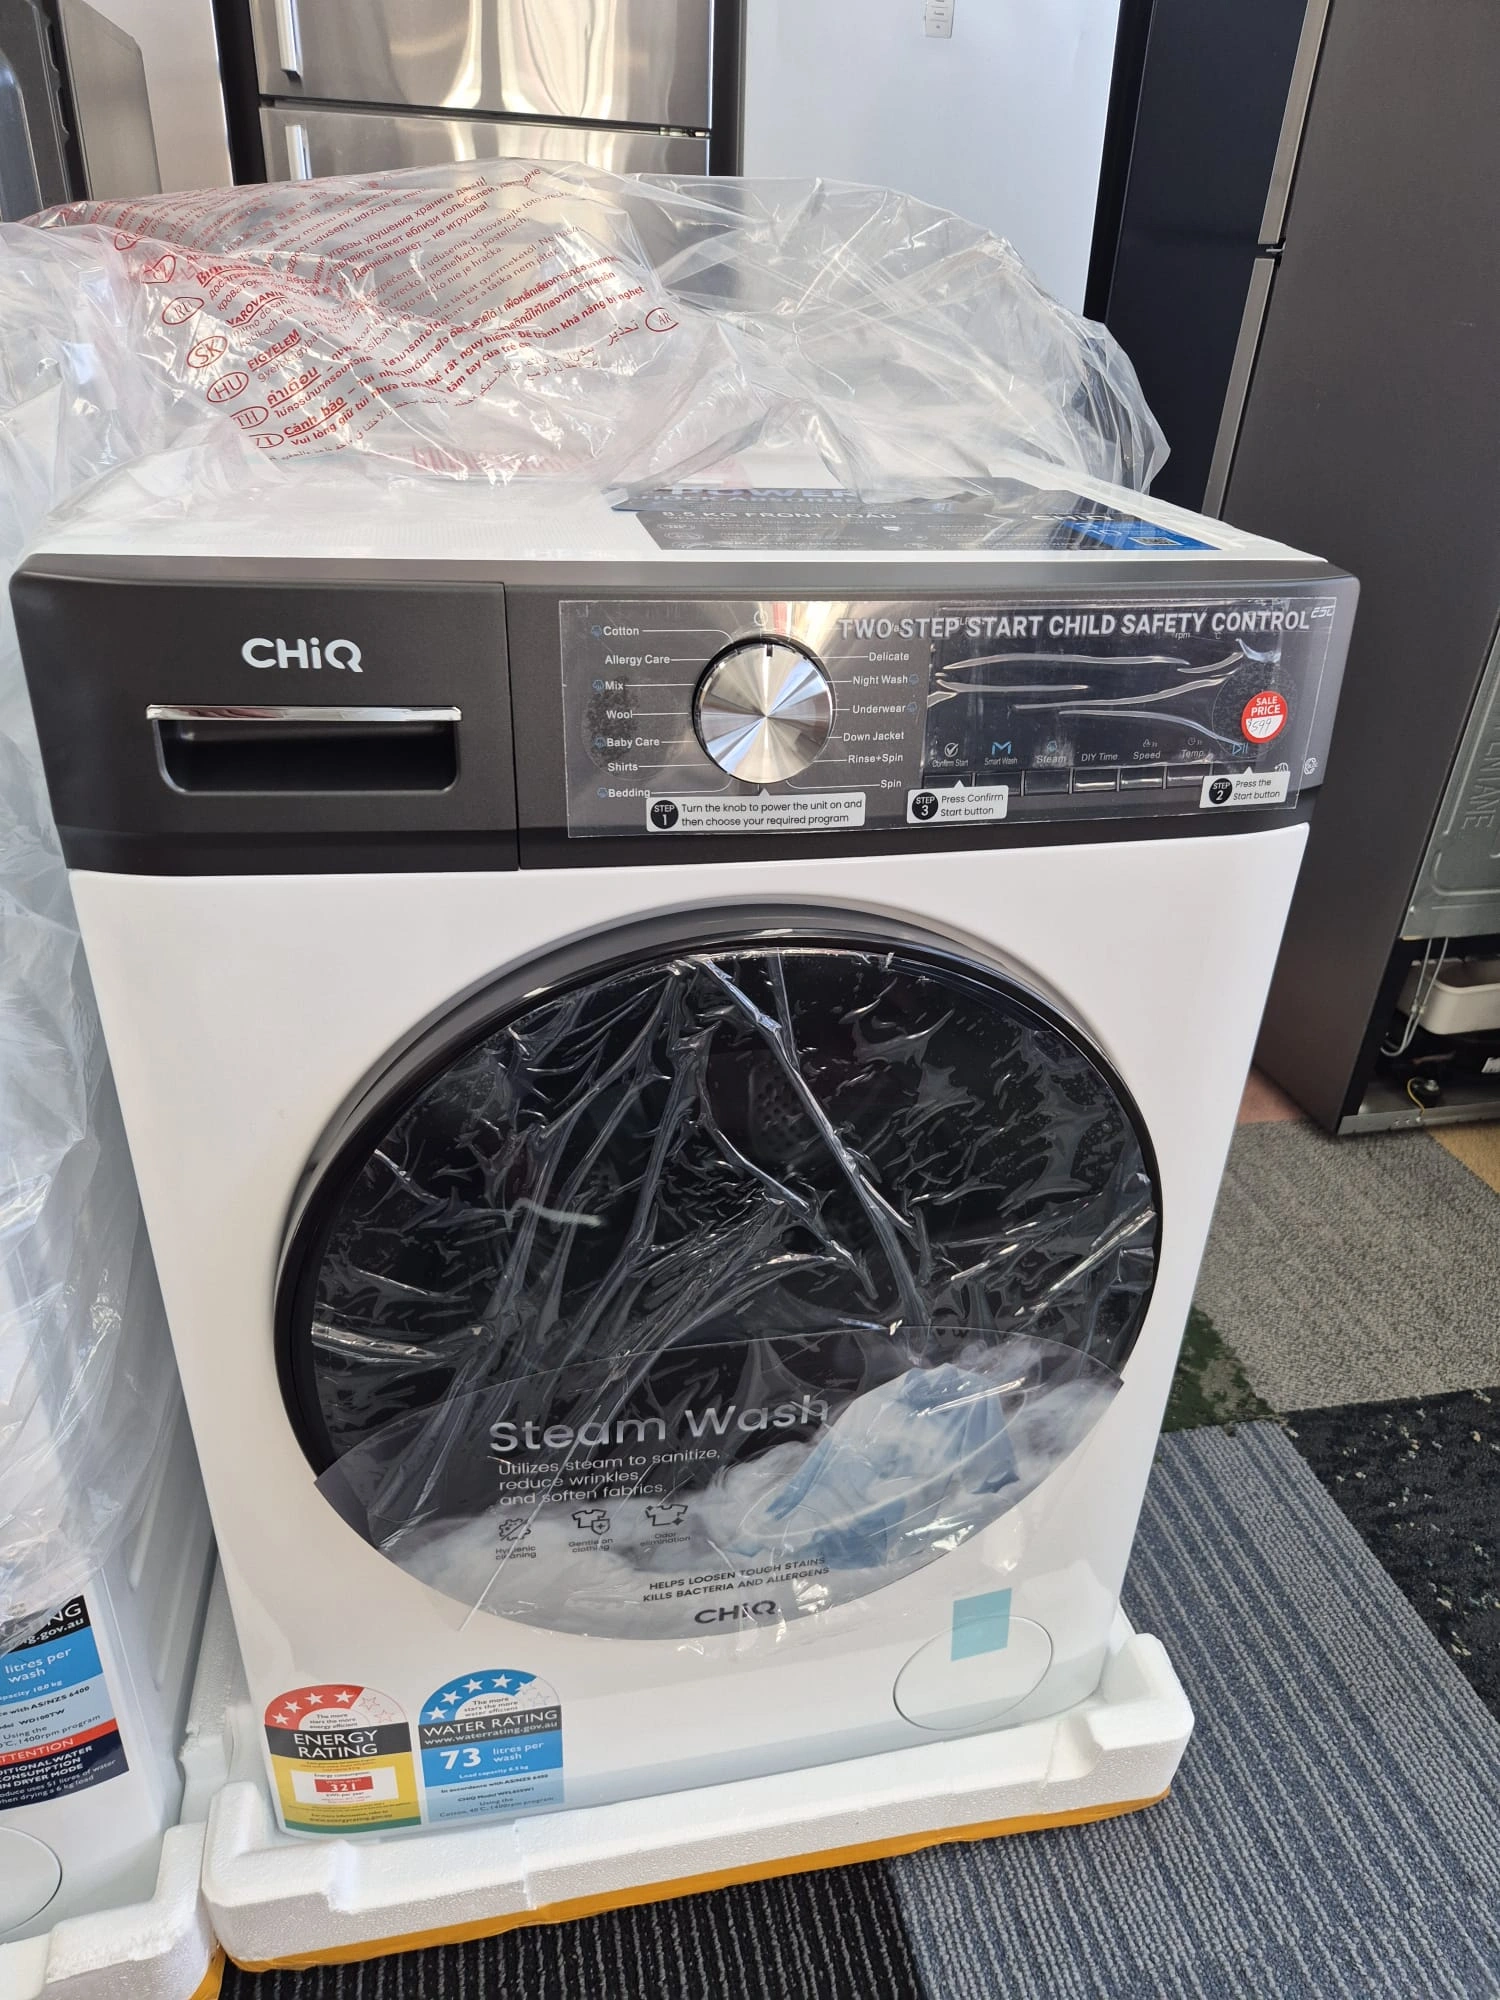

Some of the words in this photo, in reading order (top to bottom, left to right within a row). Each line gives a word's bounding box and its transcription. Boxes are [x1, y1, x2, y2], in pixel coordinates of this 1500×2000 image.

[195, 340, 224, 365] SK
[247, 329, 300, 370] FIGYELEM
[214, 375, 243, 399] HU
[838, 618, 893, 640] TWO
[899, 617, 960, 640] STEP
[966, 615, 1043, 638] START
[1049, 614, 1116, 637] CHILD
[1120, 611, 1207, 634] SAFETY
[1211, 609, 1310, 633] CONTROL
[603, 626, 640, 636] Cotton
[241, 637, 363, 672] CHiQ
[604, 655, 643, 667] Allergy
[644, 654, 671, 664] Care
[868, 652, 910, 662] Delicate
[605, 681, 624, 690] Mix
[852, 675, 879, 687] Night
[881, 674, 908, 684] Wash
[1256, 696, 1278, 706] SALE
[606, 710, 633, 719] Wool
[852, 704, 906, 714] Underwear
[1250, 704, 1281, 717] PRICE
[843, 732, 871, 742] Down
[873, 731, 905, 741] Jacket
[606, 738, 633, 749] Baby
[635, 737, 660, 746] Care
[848, 753, 904, 764] Rinse+Spin
[1036, 754, 1067, 764] Steam
[1081, 753, 1097, 762] DIY
[1099, 752, 1118, 761] Time
[1133, 751, 1161, 760] Speed
[607, 762, 639, 772] Shirts
[880, 779, 902, 790] Spin
[1212, 781, 1231, 790] STEP
[1235, 780, 1257, 788] Press
[1258, 779, 1271, 787] the
[608, 788, 651, 799] Bedding
[941, 795, 966, 804] Press
[968, 792, 1004, 803] Confirm
[1215, 790, 1223, 801] 2
[1233, 792, 1252, 801] Start
[1254, 790, 1281, 799] button
[915, 796, 936, 805] STEP
[654, 804, 675, 813] STEP
[681, 803, 703, 813] Turn
[705, 803, 721, 812] the
[723, 803, 747, 812] knob
[749, 804, 759, 812] to
[761, 803, 791, 814] power
[793, 802, 809, 811] the
[810, 801, 828, 810] unit
[830, 801, 842, 809] on
[843, 800, 862, 809] and
[921, 805, 929, 817] 3
[941, 808, 962, 817] Start
[964, 806, 994, 816] button
[662, 814, 668, 826] 1
[681, 817, 704, 827] then
[705, 817, 741, 826] choose
[743, 817, 764, 827] your
[766, 815, 806, 827] required
[808, 815, 849, 826] program
[489, 1416, 666, 1452] Steam
[684, 1394, 829, 1438] Wash
[498, 1461, 559, 1476] Utilizes
[564, 1457, 623, 1472] steam
[629, 1455, 648, 1467] to
[652, 1448, 721, 1464] sanitize,
[499, 1477, 564, 1492] reduce
[500, 1492, 536, 1506] and
[541, 1489, 598, 1504] soften
[603, 1483, 666, 1498] fabrics.
[649, 1578, 685, 1591] HELPS
[688, 1572, 736, 1586] LOOSEN
[740, 1563, 781, 1577] TOUGH
[785, 1557, 826, 1570] STAINS
[643, 1591, 673, 1603] KILLS
[676, 1583, 734, 1598] BACTERIA
[737, 1578, 764, 1588] AND
[766, 1566, 830, 1585] ALLERGENS
[694, 1600, 777, 1625] CHiQ
[5, 1658, 43, 1675] litres
[47, 1648, 72, 1665] per
[8, 1667, 46, 1683] wash
[61, 1715, 101, 1734] program
[424, 1720, 484, 1737] WATER
[492, 1710, 557, 1729] RATING
[3, 1729, 30, 1741] Using
[32, 1726, 47, 1734] the
[293, 1730, 378, 1746] ENERGY
[424, 1722, 558, 1745] www.waterrating.gov.au
[53, 1745, 93, 1763] WATER
[298, 1744, 378, 1759] RATING
[493, 1746, 522, 1755] litres
[525, 1742, 545, 1752] per
[440, 1747, 482, 1770] 73
[493, 1753, 522, 1763] wash
[13, 1774, 49, 1787] DRYER
[51, 1763, 84, 1777] MODE
[330, 1783, 357, 1792] 321
